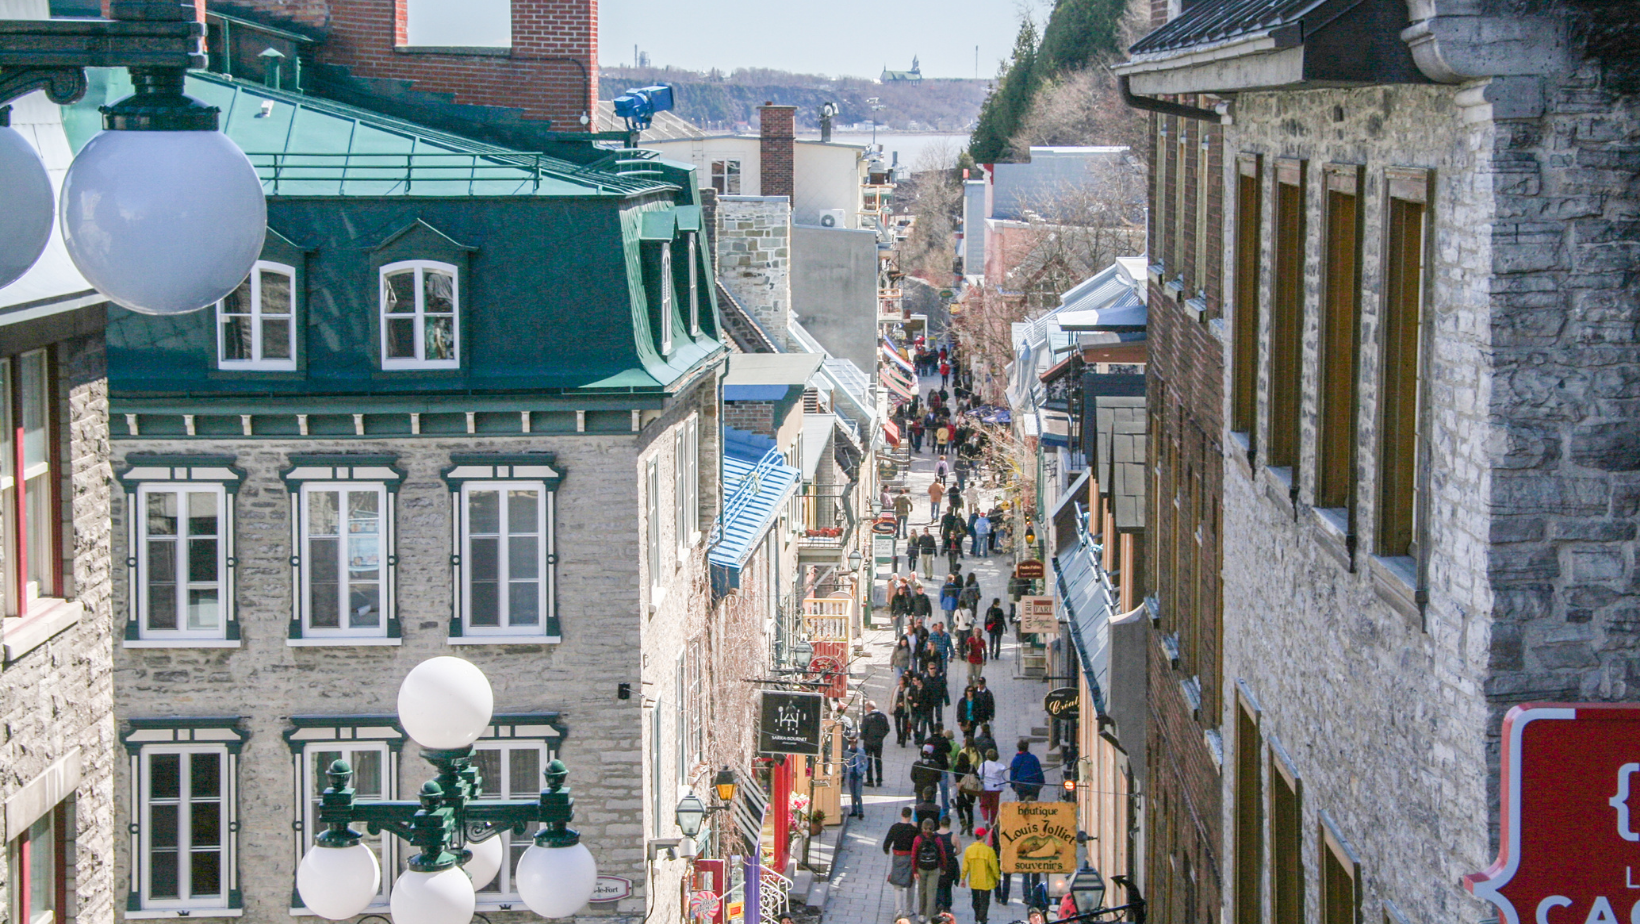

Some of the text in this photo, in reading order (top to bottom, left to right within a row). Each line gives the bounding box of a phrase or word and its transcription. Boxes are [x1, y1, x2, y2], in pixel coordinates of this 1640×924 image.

[1017, 806, 1059, 818] boutique
[1001, 819, 1076, 845] Louis Jolliet
[1015, 860, 1063, 871] souvenirs
